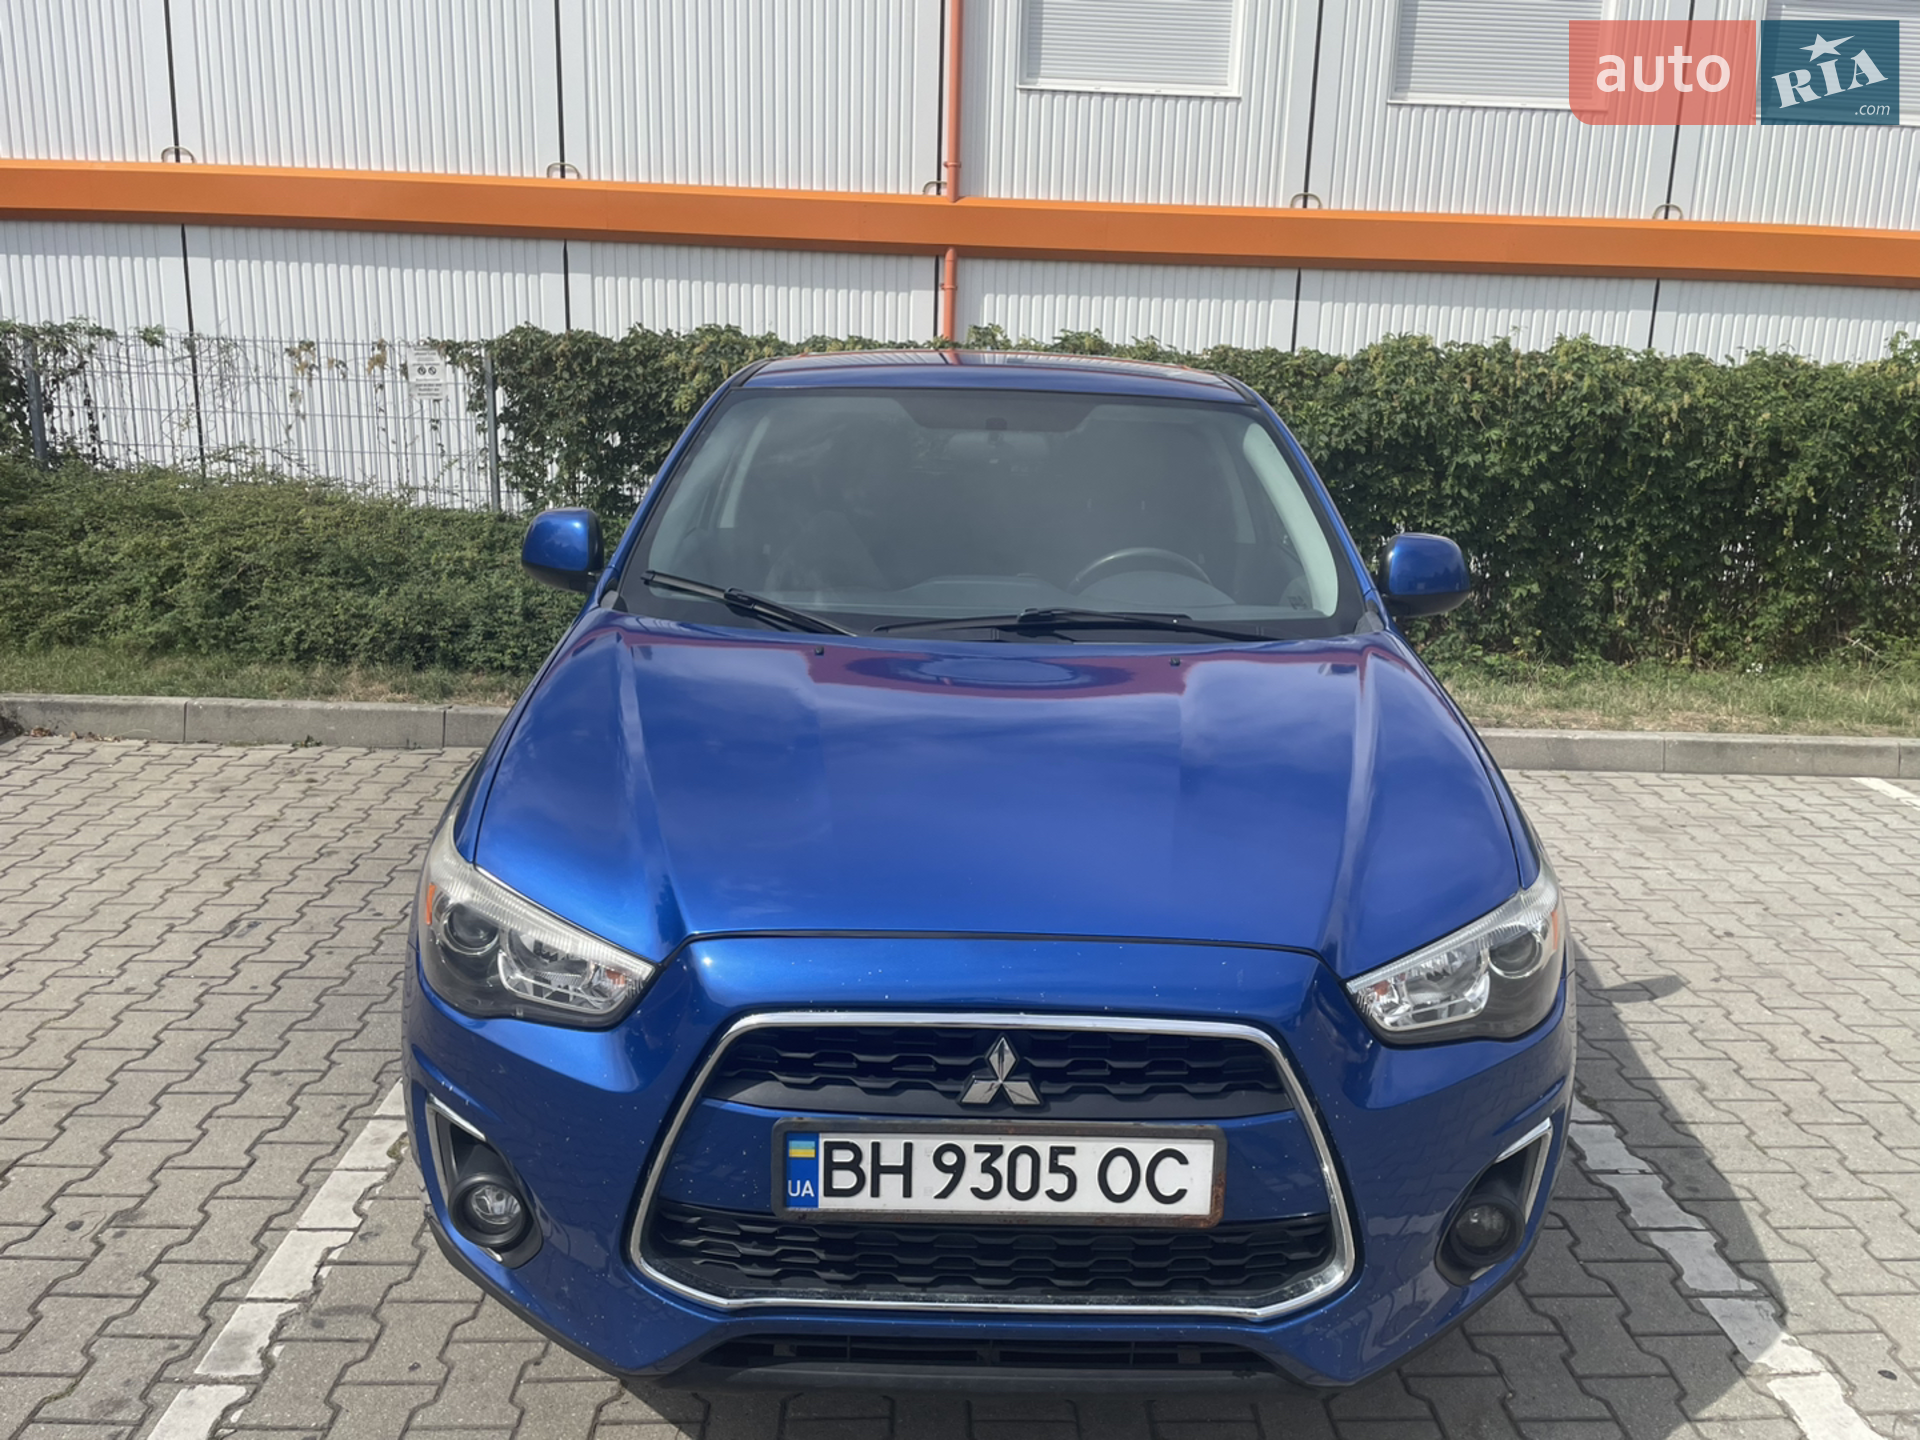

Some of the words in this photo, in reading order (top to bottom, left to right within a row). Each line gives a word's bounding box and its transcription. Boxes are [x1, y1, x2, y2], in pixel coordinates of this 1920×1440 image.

[788, 1179, 815, 1197] UA
[822, 1140, 913, 1198] BH
[932, 1143, 1077, 1201] 9305
[1097, 1147, 1189, 1204] OC
